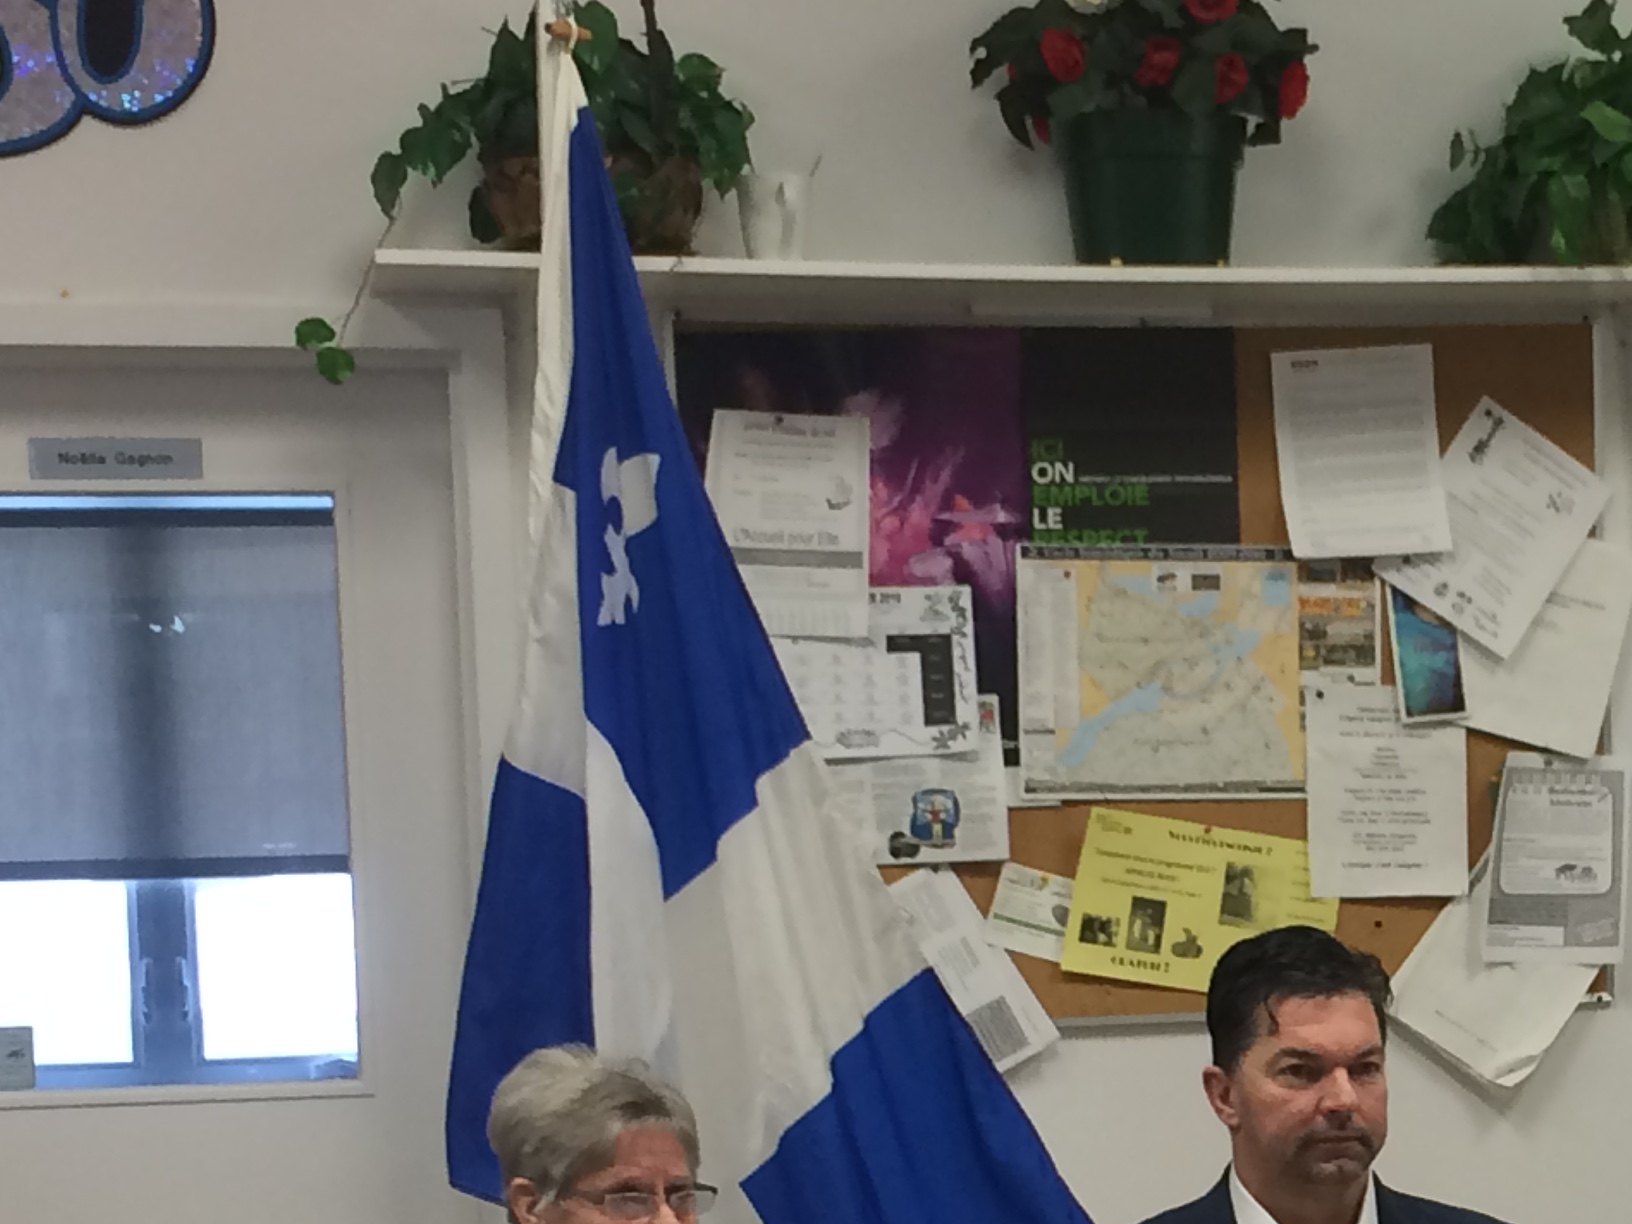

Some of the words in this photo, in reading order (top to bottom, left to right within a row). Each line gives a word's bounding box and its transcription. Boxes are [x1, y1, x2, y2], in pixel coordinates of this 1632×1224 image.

[1032, 438, 1063, 459] ICI
[1031, 461, 1075, 484] ON
[1032, 485, 1150, 506] EMPLOIE
[1032, 507, 1063, 529] LE
